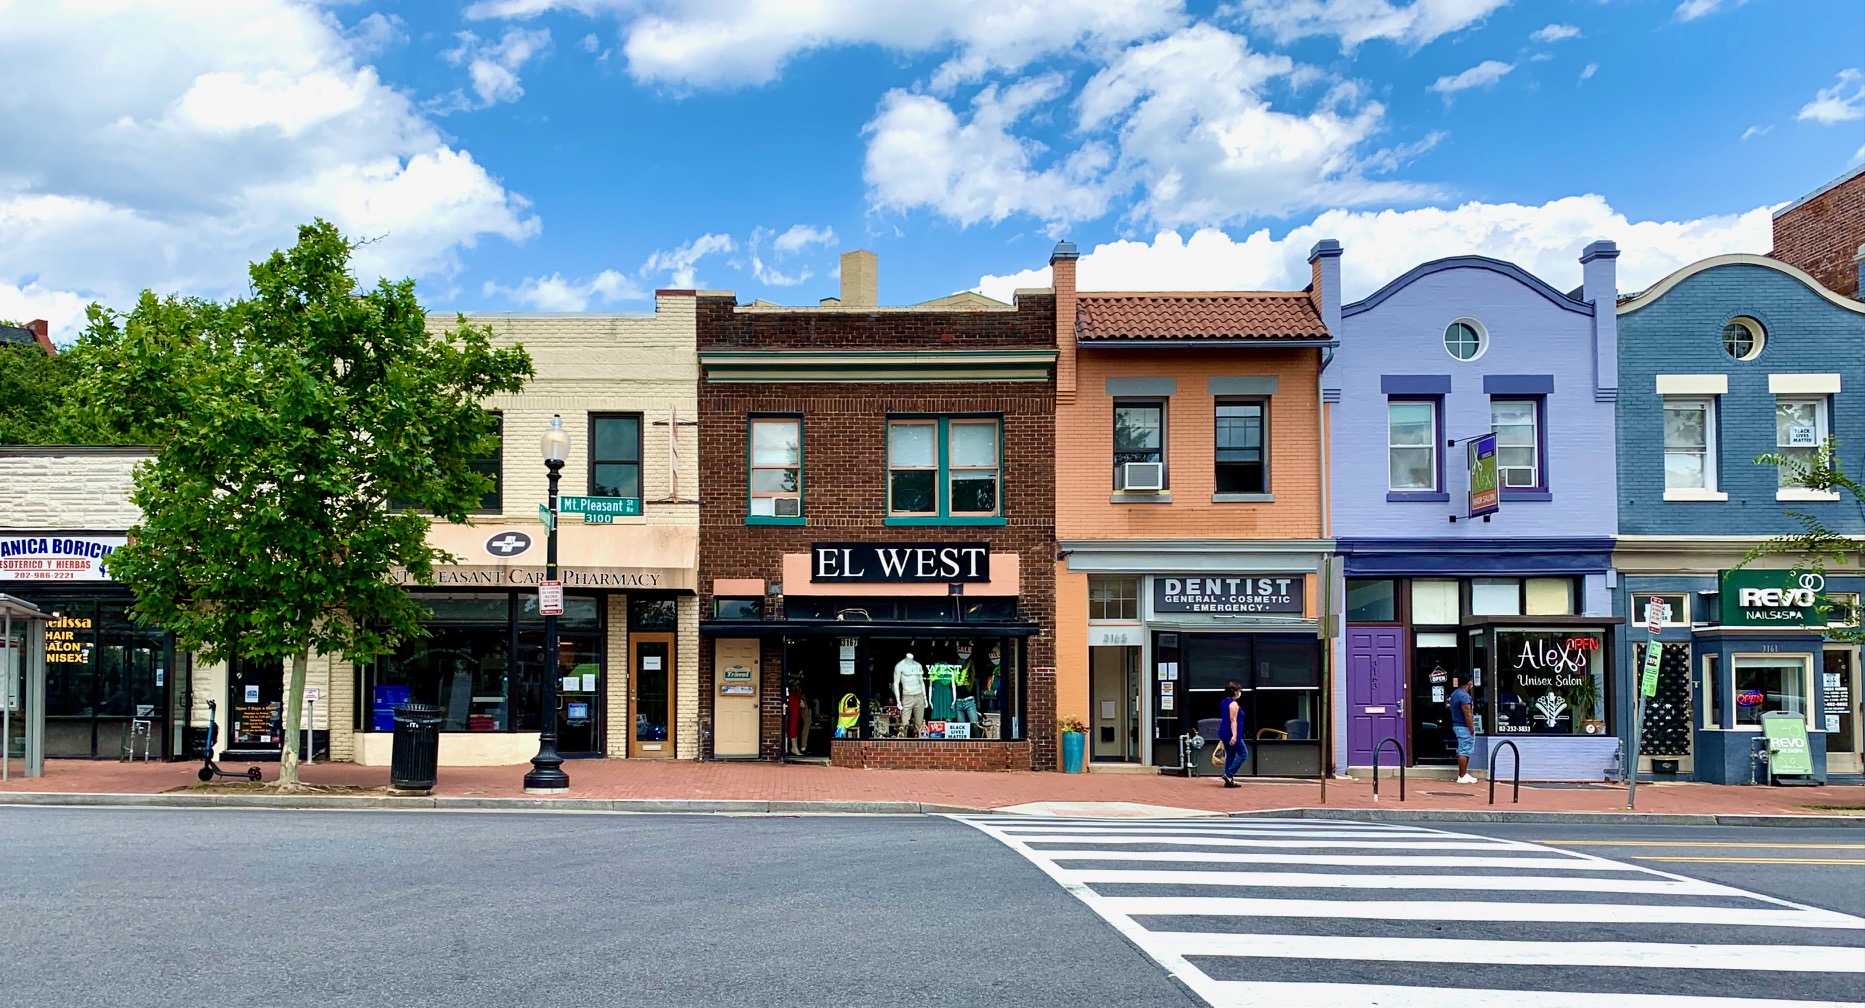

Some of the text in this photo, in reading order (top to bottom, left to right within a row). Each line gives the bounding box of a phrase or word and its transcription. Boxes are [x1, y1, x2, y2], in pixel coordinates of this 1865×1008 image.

[564, 498, 579, 511] Mt.
[581, 499, 623, 512] Pleasant
[586, 514, 611, 522] 3100
[1, 539, 112, 558] ANICA BORICU
[56, 560, 91, 568] HIERBAS
[816, 548, 986, 577] EL WEST
[508, 569, 546, 585] CAR
[563, 570, 661, 585] PHARMACY
[1165, 579, 1291, 595] DENTIST
[1165, 595, 1217, 603] GENERAL
[1739, 588, 1816, 607] REVO
[1746, 611, 1804, 619] NAILS&SPA
[45, 616, 92, 628] elissa
[45, 631, 74, 640] HAIR
[1103, 633, 1128, 644] 3165
[45, 642, 81, 652] ALON
[1565, 637, 1599, 650] OPEN
[1762, 644, 1778, 653] 3161
[956, 646, 973, 654] SALE
[46, 653, 83, 663] NISEX
[1516, 674, 1583, 687] Unisex Salon
[1736, 694, 1764, 703] OPEN
[1770, 738, 1805, 748] REVO
